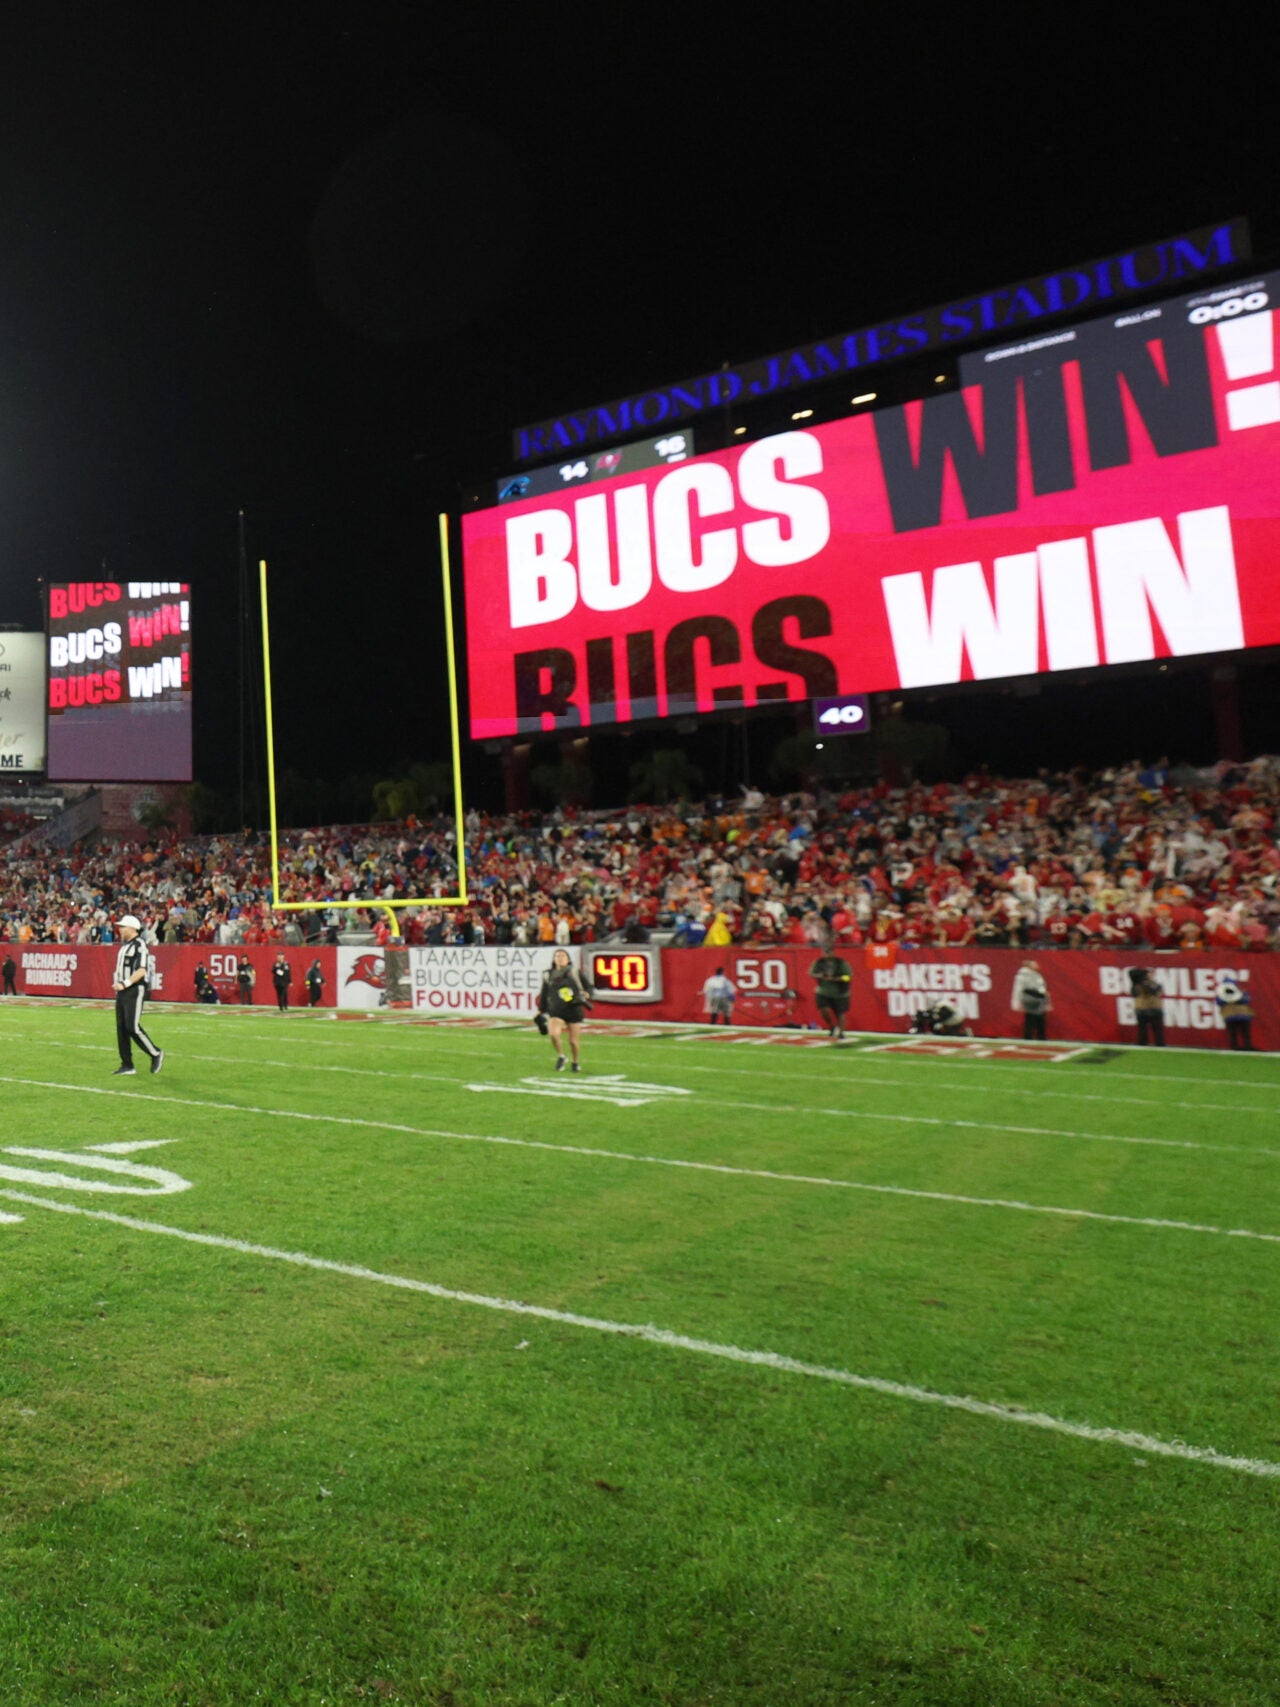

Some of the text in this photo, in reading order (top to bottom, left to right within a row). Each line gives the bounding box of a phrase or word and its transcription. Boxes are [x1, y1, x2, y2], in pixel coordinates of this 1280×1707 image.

[518, 224, 1238, 459] RAYMOND JAMES STADIUM
[506, 309, 1280, 627] BUCS WIN!
[513, 505, 1245, 731] BUCS WIN
[51, 601, 189, 667] BUCS WIN!
[50, 652, 189, 708] BUCS WIN!
[819, 704, 863, 725] 40
[22, 953, 77, 970] RACHAAD'S
[210, 954, 237, 976] 50
[416, 948, 538, 967] TAMPA BAY
[596, 955, 646, 990] 40
[26, 969, 72, 986] RUNNERS
[416, 969, 546, 989] BUCCANEE
[736, 959, 787, 990] 50
[873, 963, 992, 992] BAKER'S
[1116, 997, 1227, 1030] BNC
